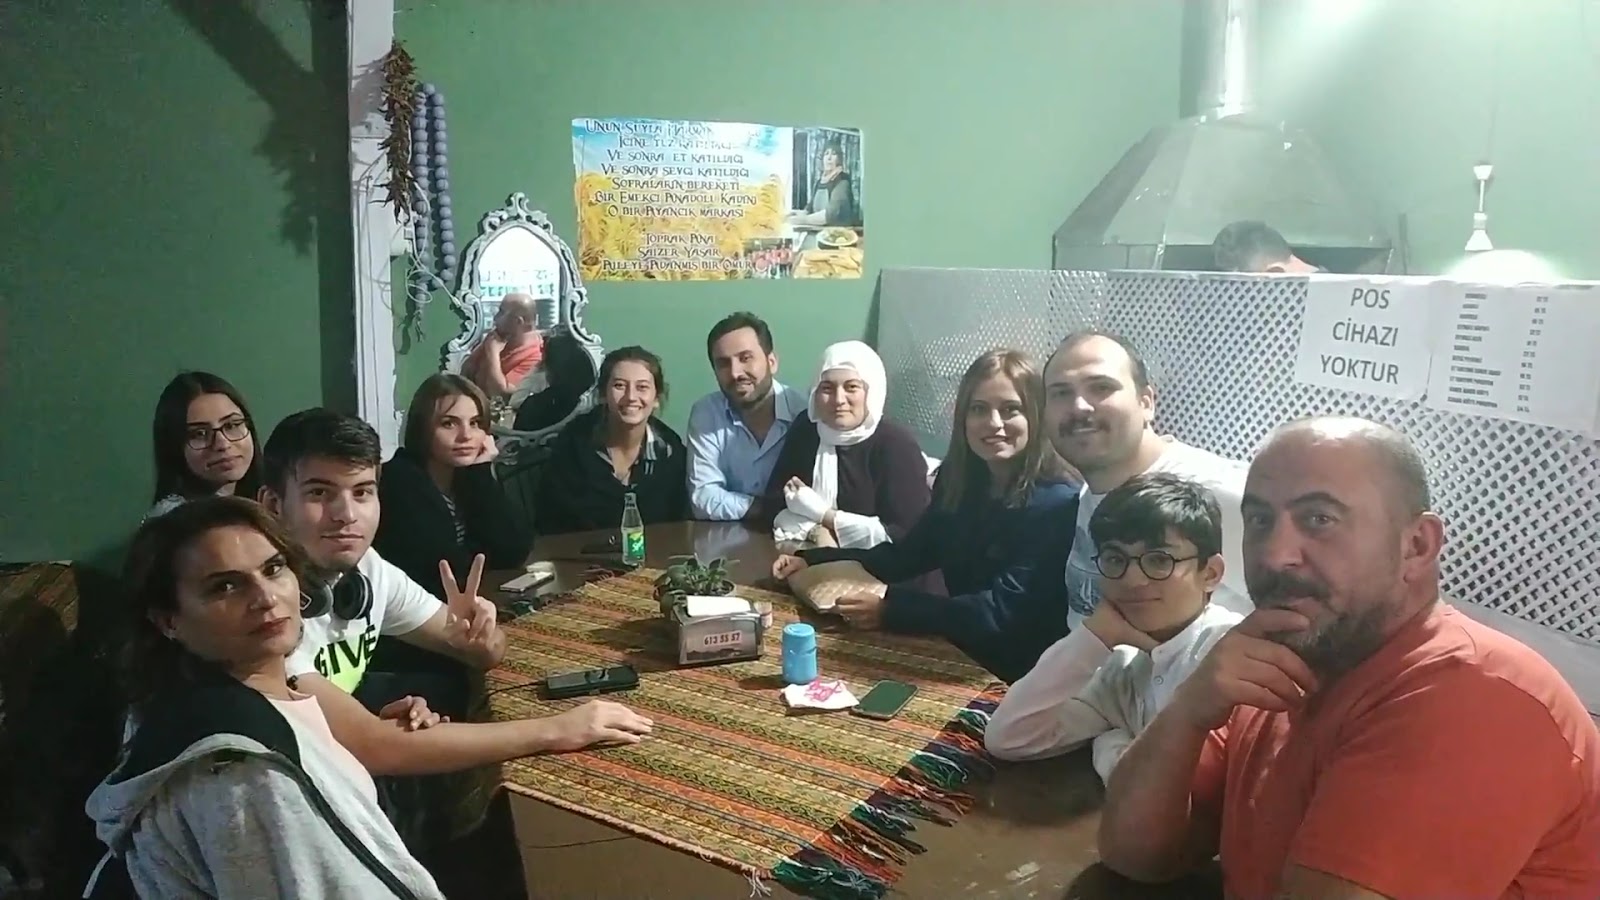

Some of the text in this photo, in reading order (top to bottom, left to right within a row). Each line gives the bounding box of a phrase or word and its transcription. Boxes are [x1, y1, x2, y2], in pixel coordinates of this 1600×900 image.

[673, 153, 688, 162] ET
[1350, 287, 1391, 310] POS
[1332, 317, 1399, 347] CİHAZI
[1320, 354, 1399, 385] YOKTUR
[313, 624, 376, 678] GIVE
[704, 635, 718, 645] 613
